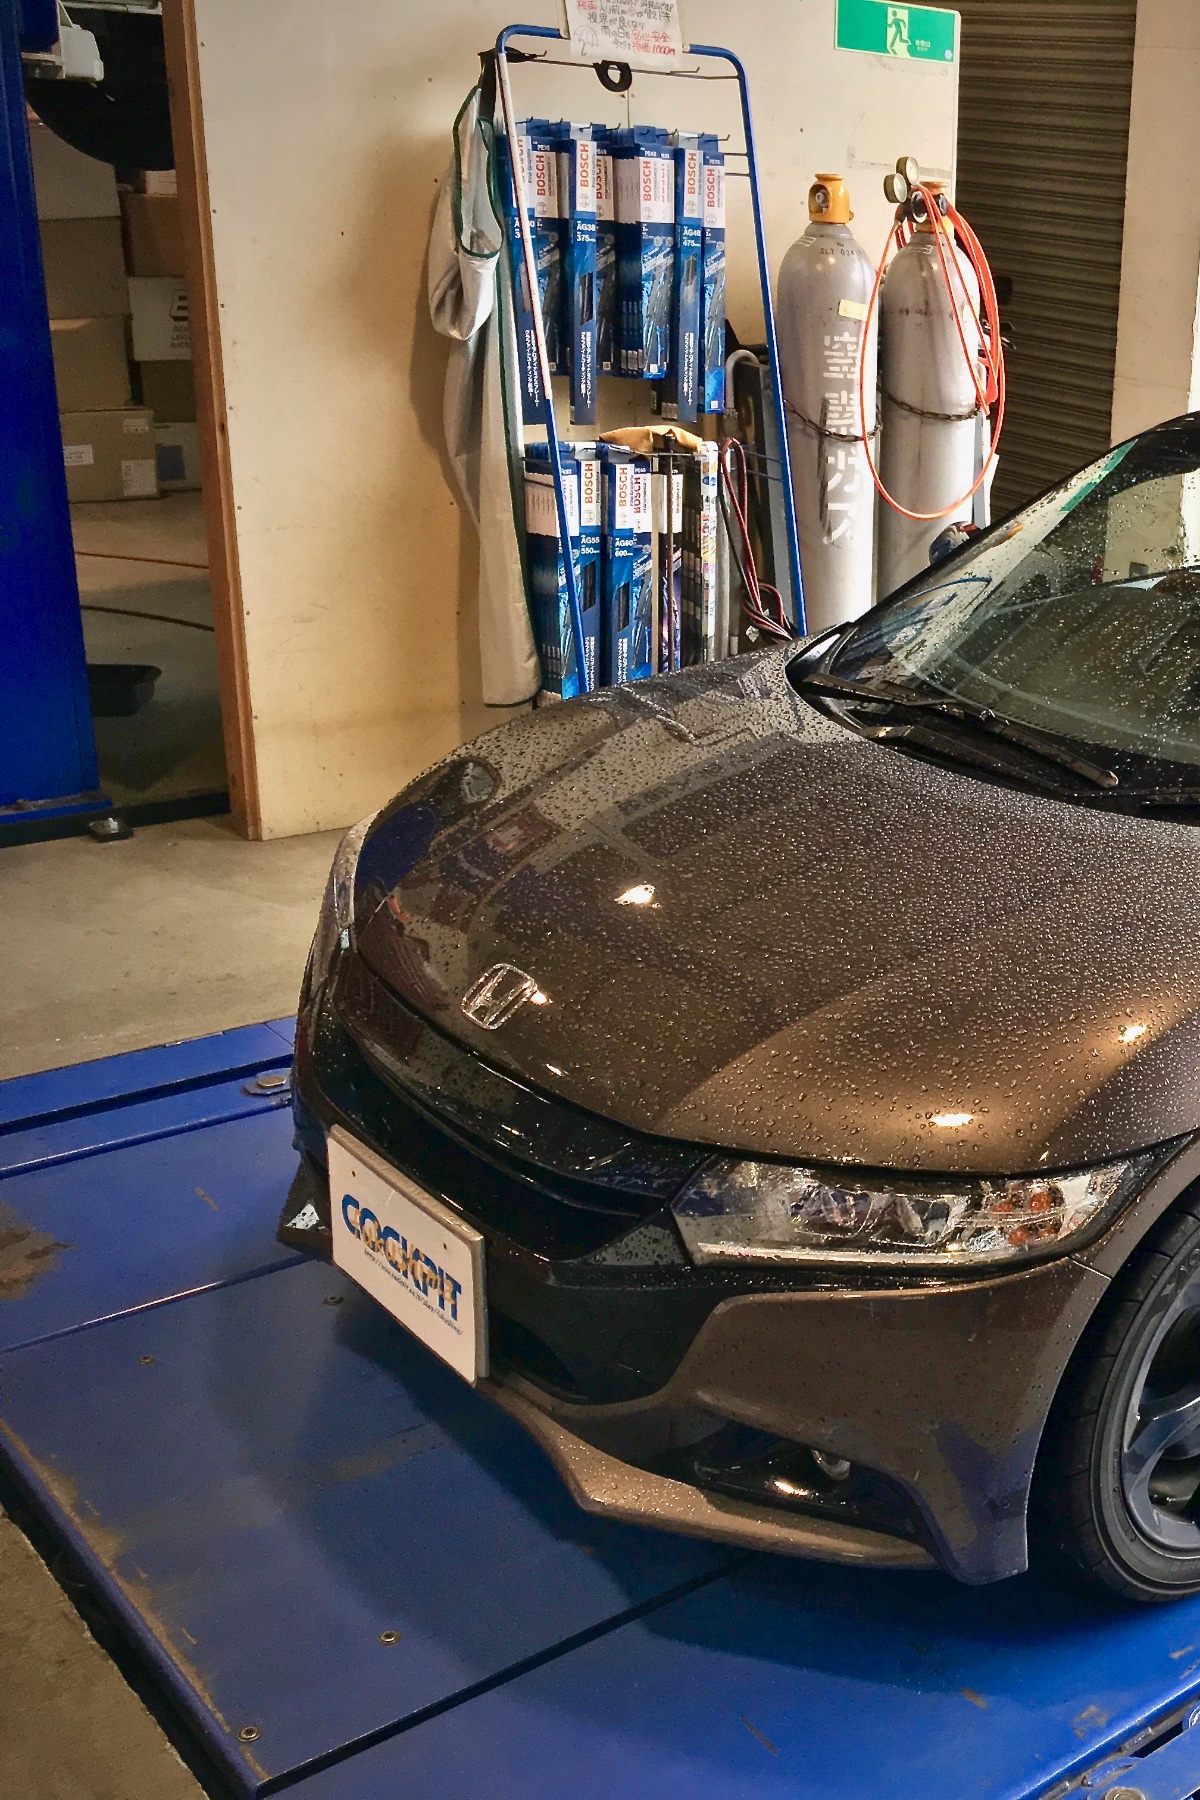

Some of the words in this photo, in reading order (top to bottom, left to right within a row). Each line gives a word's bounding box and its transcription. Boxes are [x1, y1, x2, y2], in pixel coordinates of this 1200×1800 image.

[536, 154, 546, 196] BOSCH
[579, 143, 589, 188] BOSCH
[643, 160, 652, 202] BOSCH
[687, 152, 697, 195] BOSCH
[706, 168, 716, 208] BOSCH
[584, 463, 594, 505] BOSCH
[618, 467, 628, 507] BOSCH
[580, 536, 600, 544] AG55
[341, 1193, 463, 1322] COCKPIT
